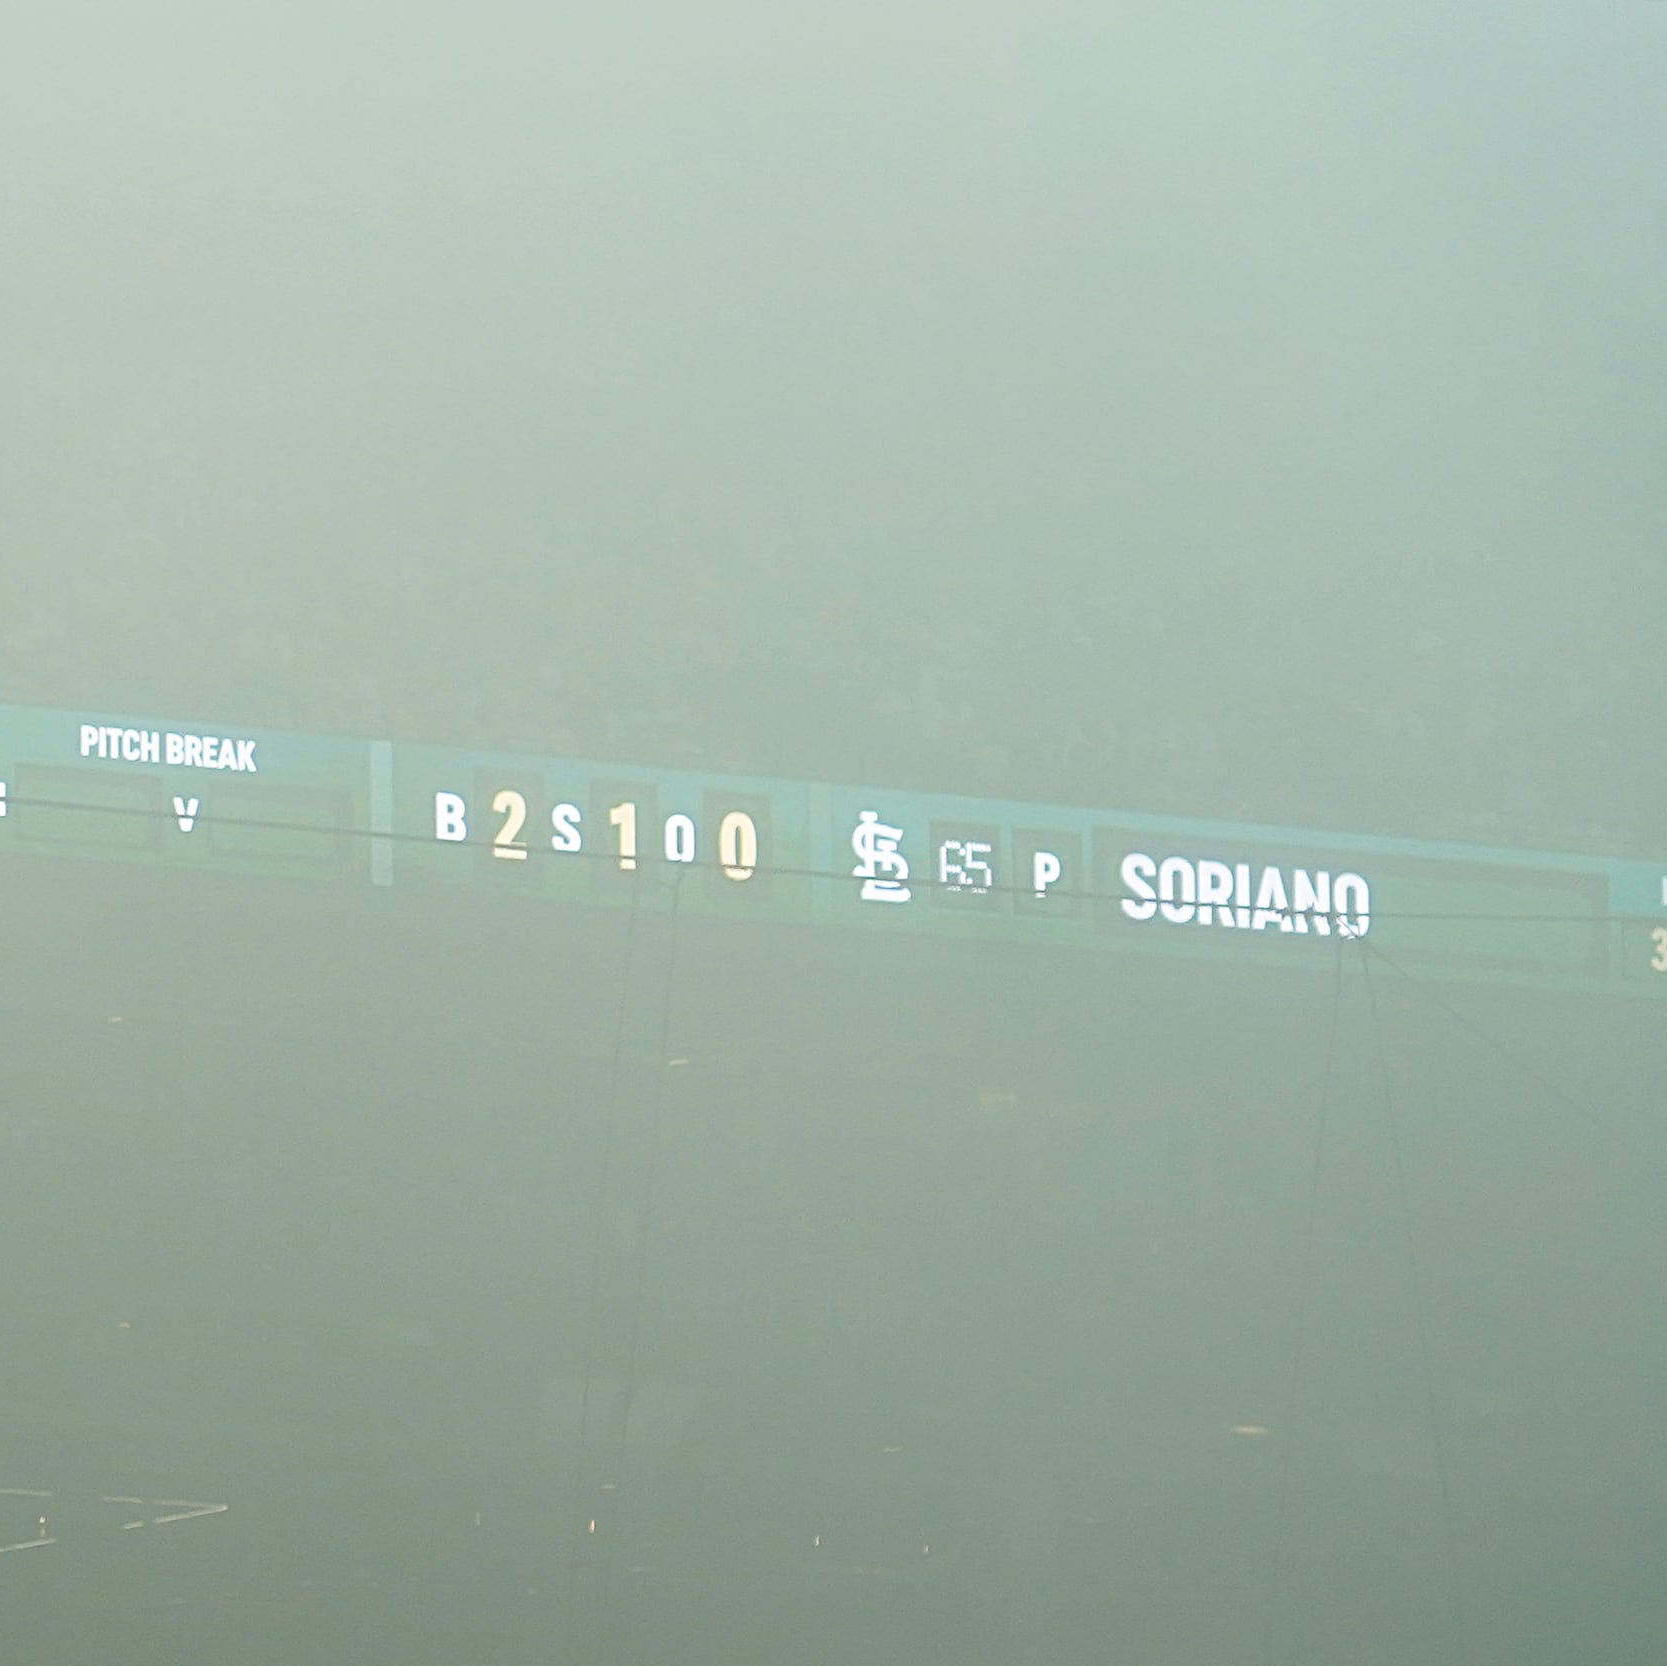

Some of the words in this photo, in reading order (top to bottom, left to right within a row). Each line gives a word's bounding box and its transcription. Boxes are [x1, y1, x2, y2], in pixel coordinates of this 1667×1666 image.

[79, 724, 160, 763] PITCH
[165, 732, 258, 773] BREAK
[172, 796, 200, 832] V
[434, 791, 467, 842] B
[492, 789, 528, 860] 2
[551, 803, 582, 852] S
[609, 802, 636, 870] 1
[1034, 851, 1061, 899] P
[1120, 852, 1371, 940] SORIANO
